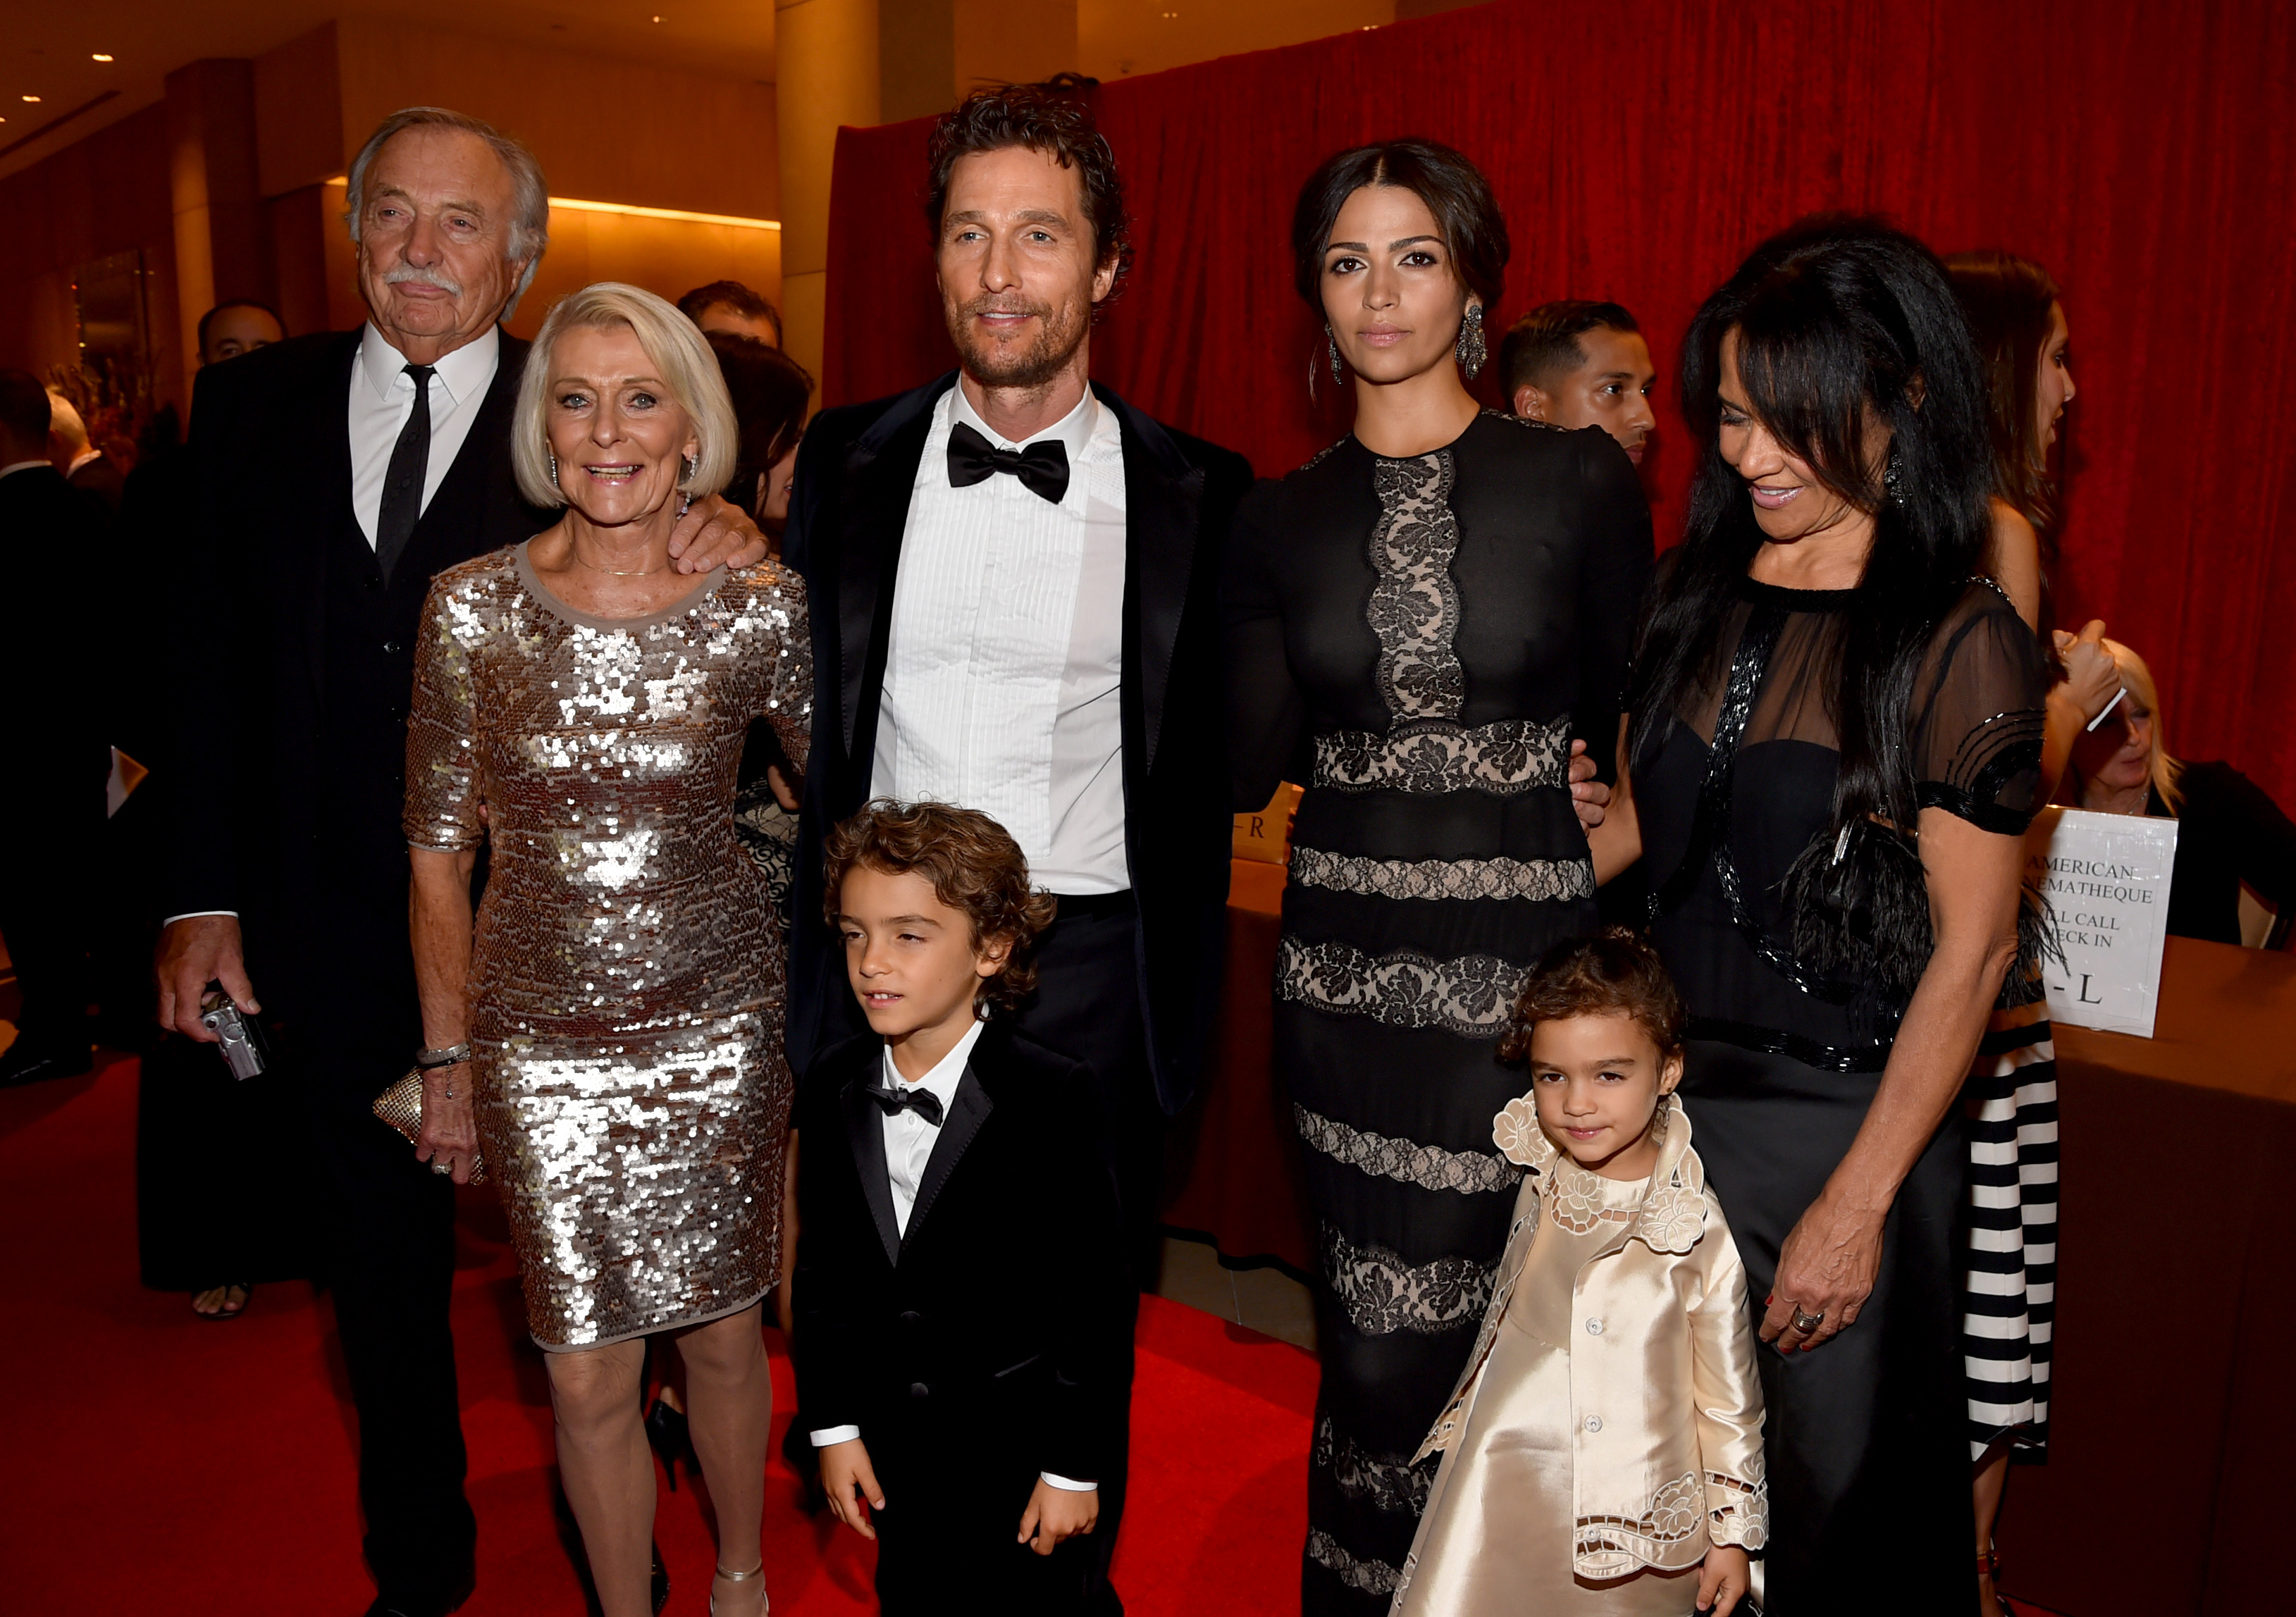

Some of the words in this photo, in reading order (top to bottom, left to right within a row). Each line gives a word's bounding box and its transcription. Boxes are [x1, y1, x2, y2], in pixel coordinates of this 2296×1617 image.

[1249, 816, 1264, 838] R
[2026, 855, 2135, 881] AMERICAN
[2023, 875, 2154, 904] NEMATHEQUE
[2039, 907, 2070, 924] ILL
[2075, 912, 2121, 930] CALL
[2044, 927, 2090, 945] HECK
[2094, 934, 2113, 948] IN
[2077, 972, 2103, 1005] L
